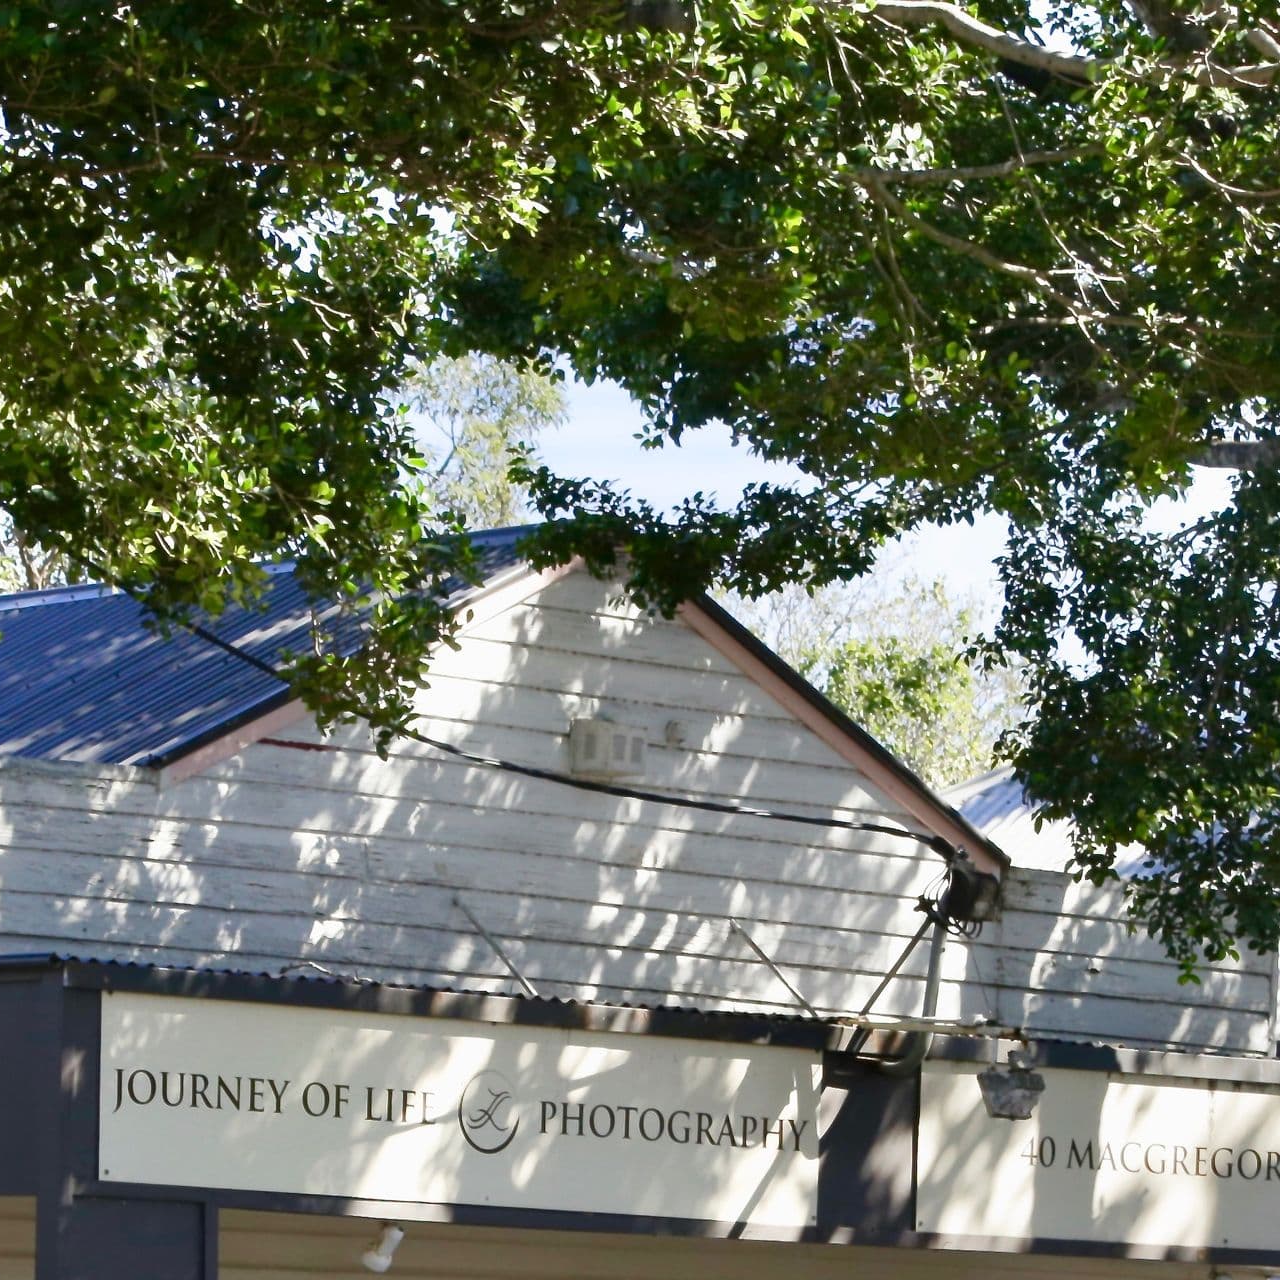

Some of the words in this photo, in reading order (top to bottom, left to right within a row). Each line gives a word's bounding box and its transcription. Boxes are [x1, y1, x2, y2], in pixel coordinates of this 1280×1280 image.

[112, 1068, 290, 1114] JOURNEY
[302, 1081, 350, 1119] OF
[365, 1086, 436, 1125] LIFE
[538, 1100, 810, 1152] PHOTOGRAPHY
[1020, 1135, 1056, 1168] 40
